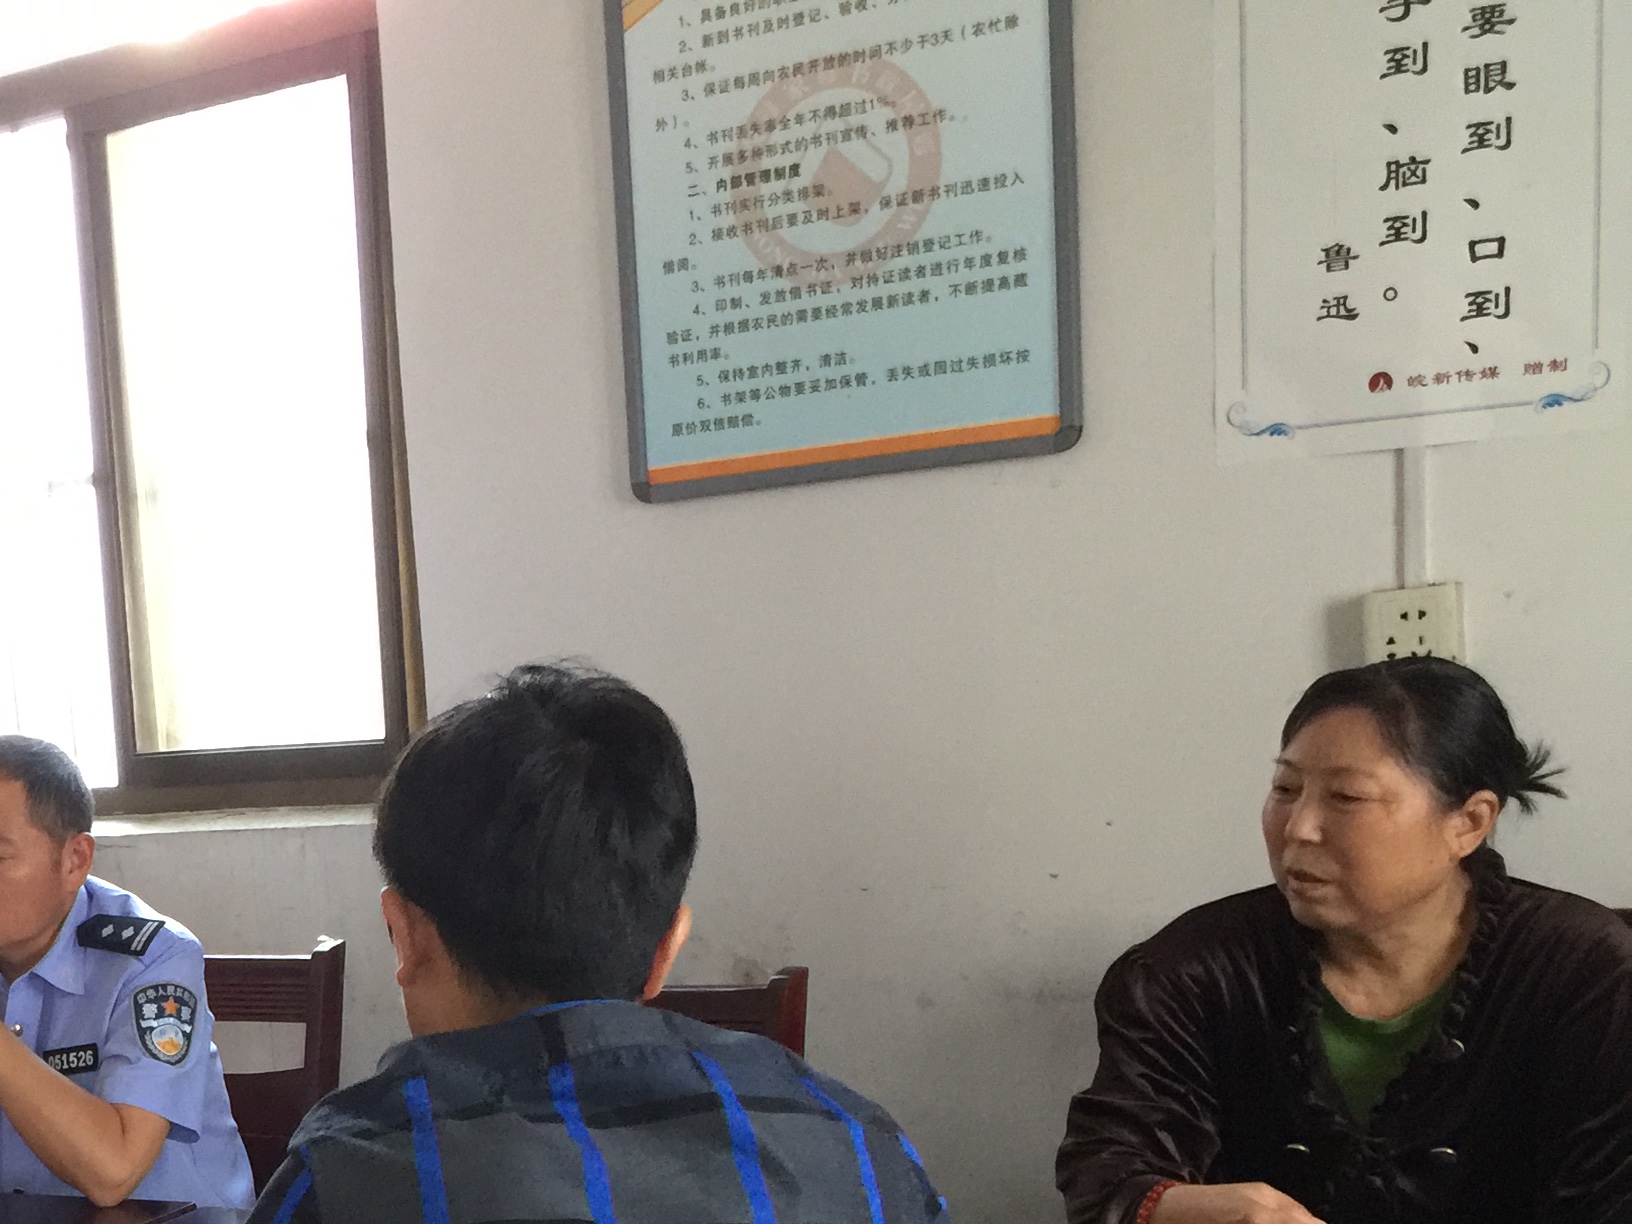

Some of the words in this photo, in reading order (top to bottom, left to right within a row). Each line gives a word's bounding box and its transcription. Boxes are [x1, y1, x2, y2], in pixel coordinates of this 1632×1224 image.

[688, 162, 801, 198] 二、内部管理制度
[1460, 3, 1517, 354] 要眼到、口到、
[662, 258, 697, 275] 借阅。
[1316, 242, 1360, 322] 鲁迅
[668, 347, 730, 368] 书利用率。
